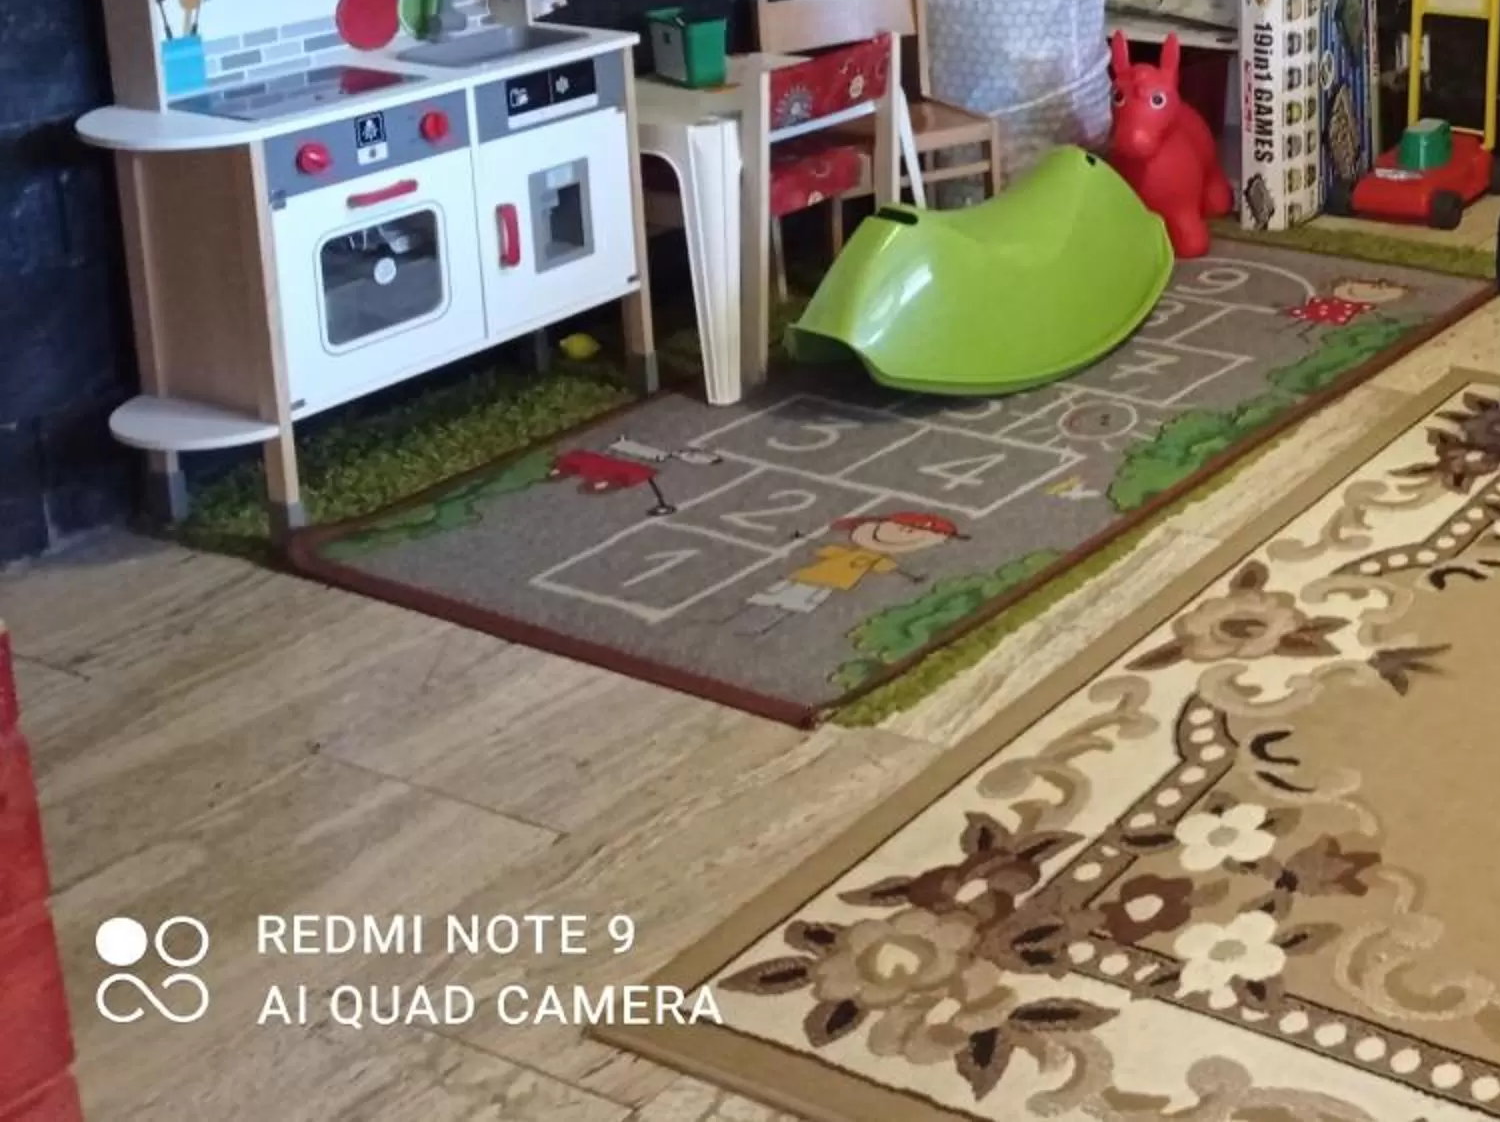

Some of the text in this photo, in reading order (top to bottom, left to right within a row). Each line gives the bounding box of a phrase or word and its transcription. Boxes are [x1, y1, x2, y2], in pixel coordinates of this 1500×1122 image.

[1253, 21, 1275, 164] 19in1 GAMES
[767, 418, 863, 452] 3
[917, 452, 1007, 491] 4
[719, 488, 818, 532] 2
